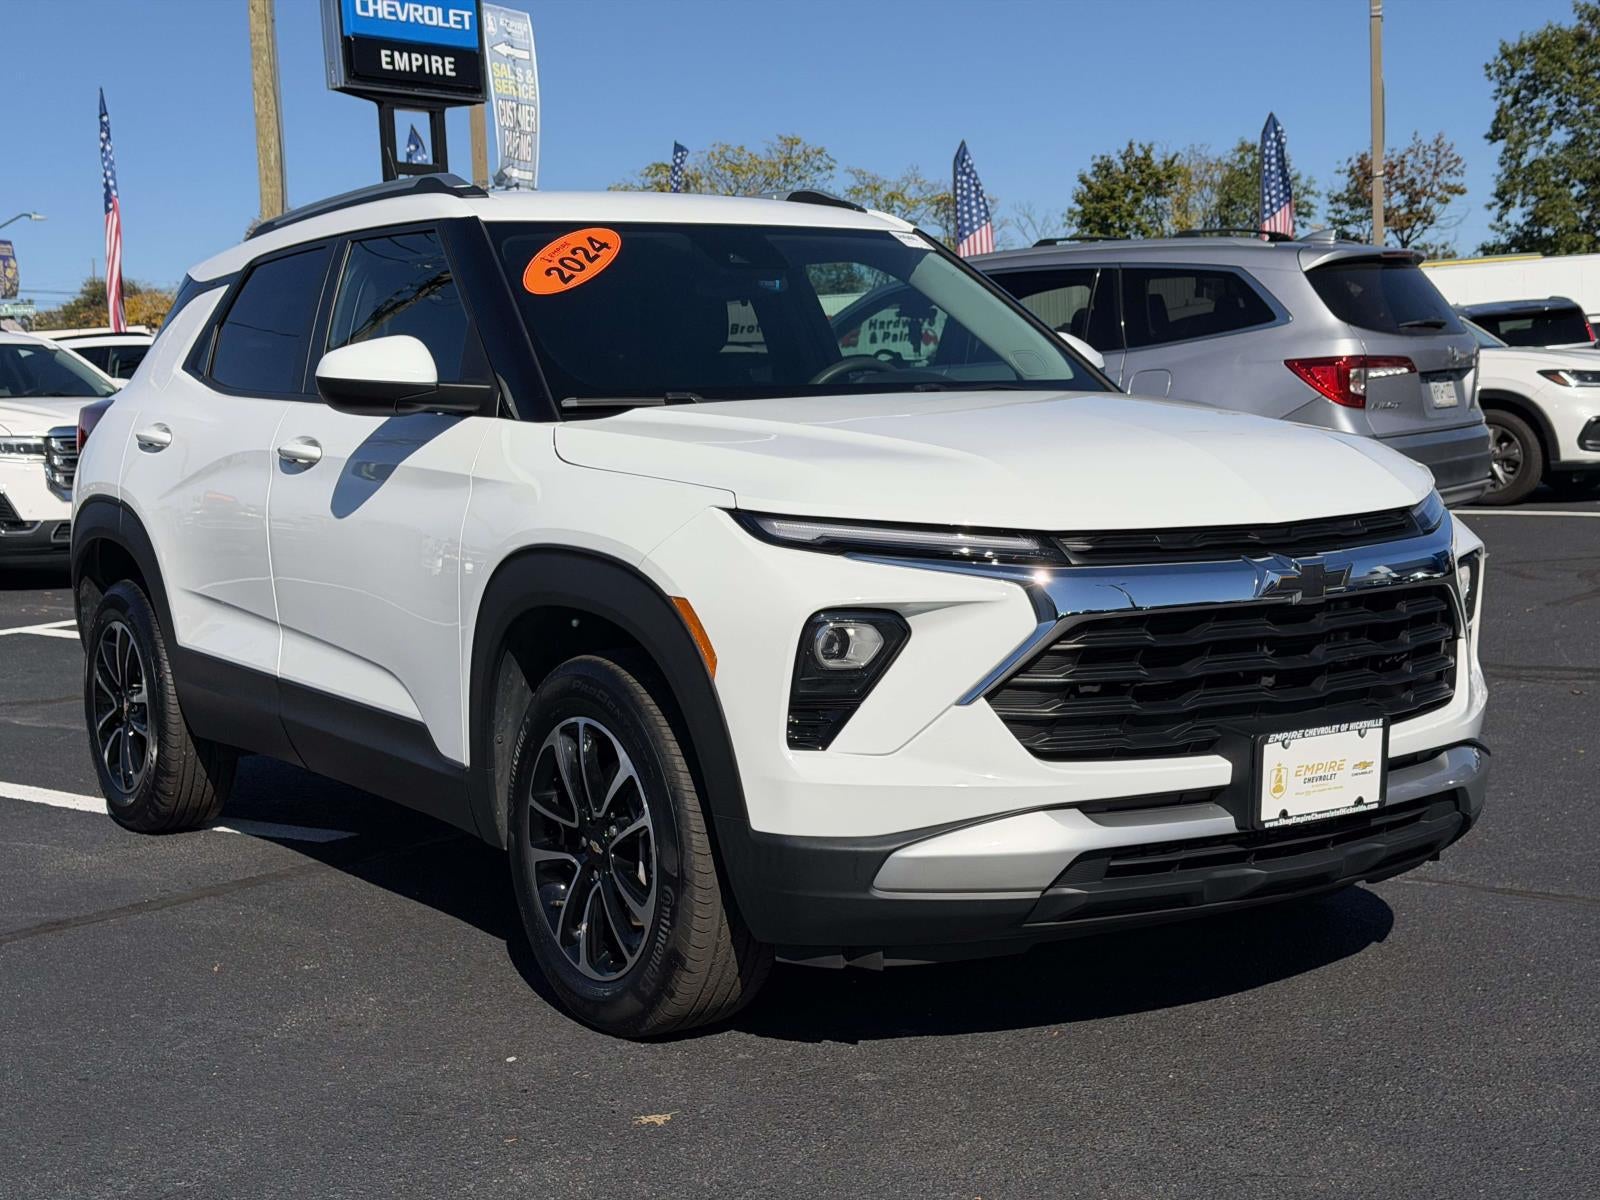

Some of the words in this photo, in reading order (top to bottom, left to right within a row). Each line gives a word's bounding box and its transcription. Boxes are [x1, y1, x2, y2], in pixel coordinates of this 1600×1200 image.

[355, 0, 473, 30] CHEVROLET
[380, 49, 457, 77] EMPIRE
[492, 61, 522, 80] SALS
[526, 68, 534, 81] &
[499, 100, 536, 131] CUSTMER
[544, 236, 612, 285] 2024
[547, 240, 571, 259] EMPIRE
[1267, 729, 1305, 744] EMPIRE
[1304, 724, 1340, 738] CHEVROLET
[1340, 722, 1349, 732] OF
[1349, 718, 1384, 731] HICKSVILLE
[1294, 758, 1347, 778] EMPIRE
[1303, 772, 1337, 785] CHEVROLET
